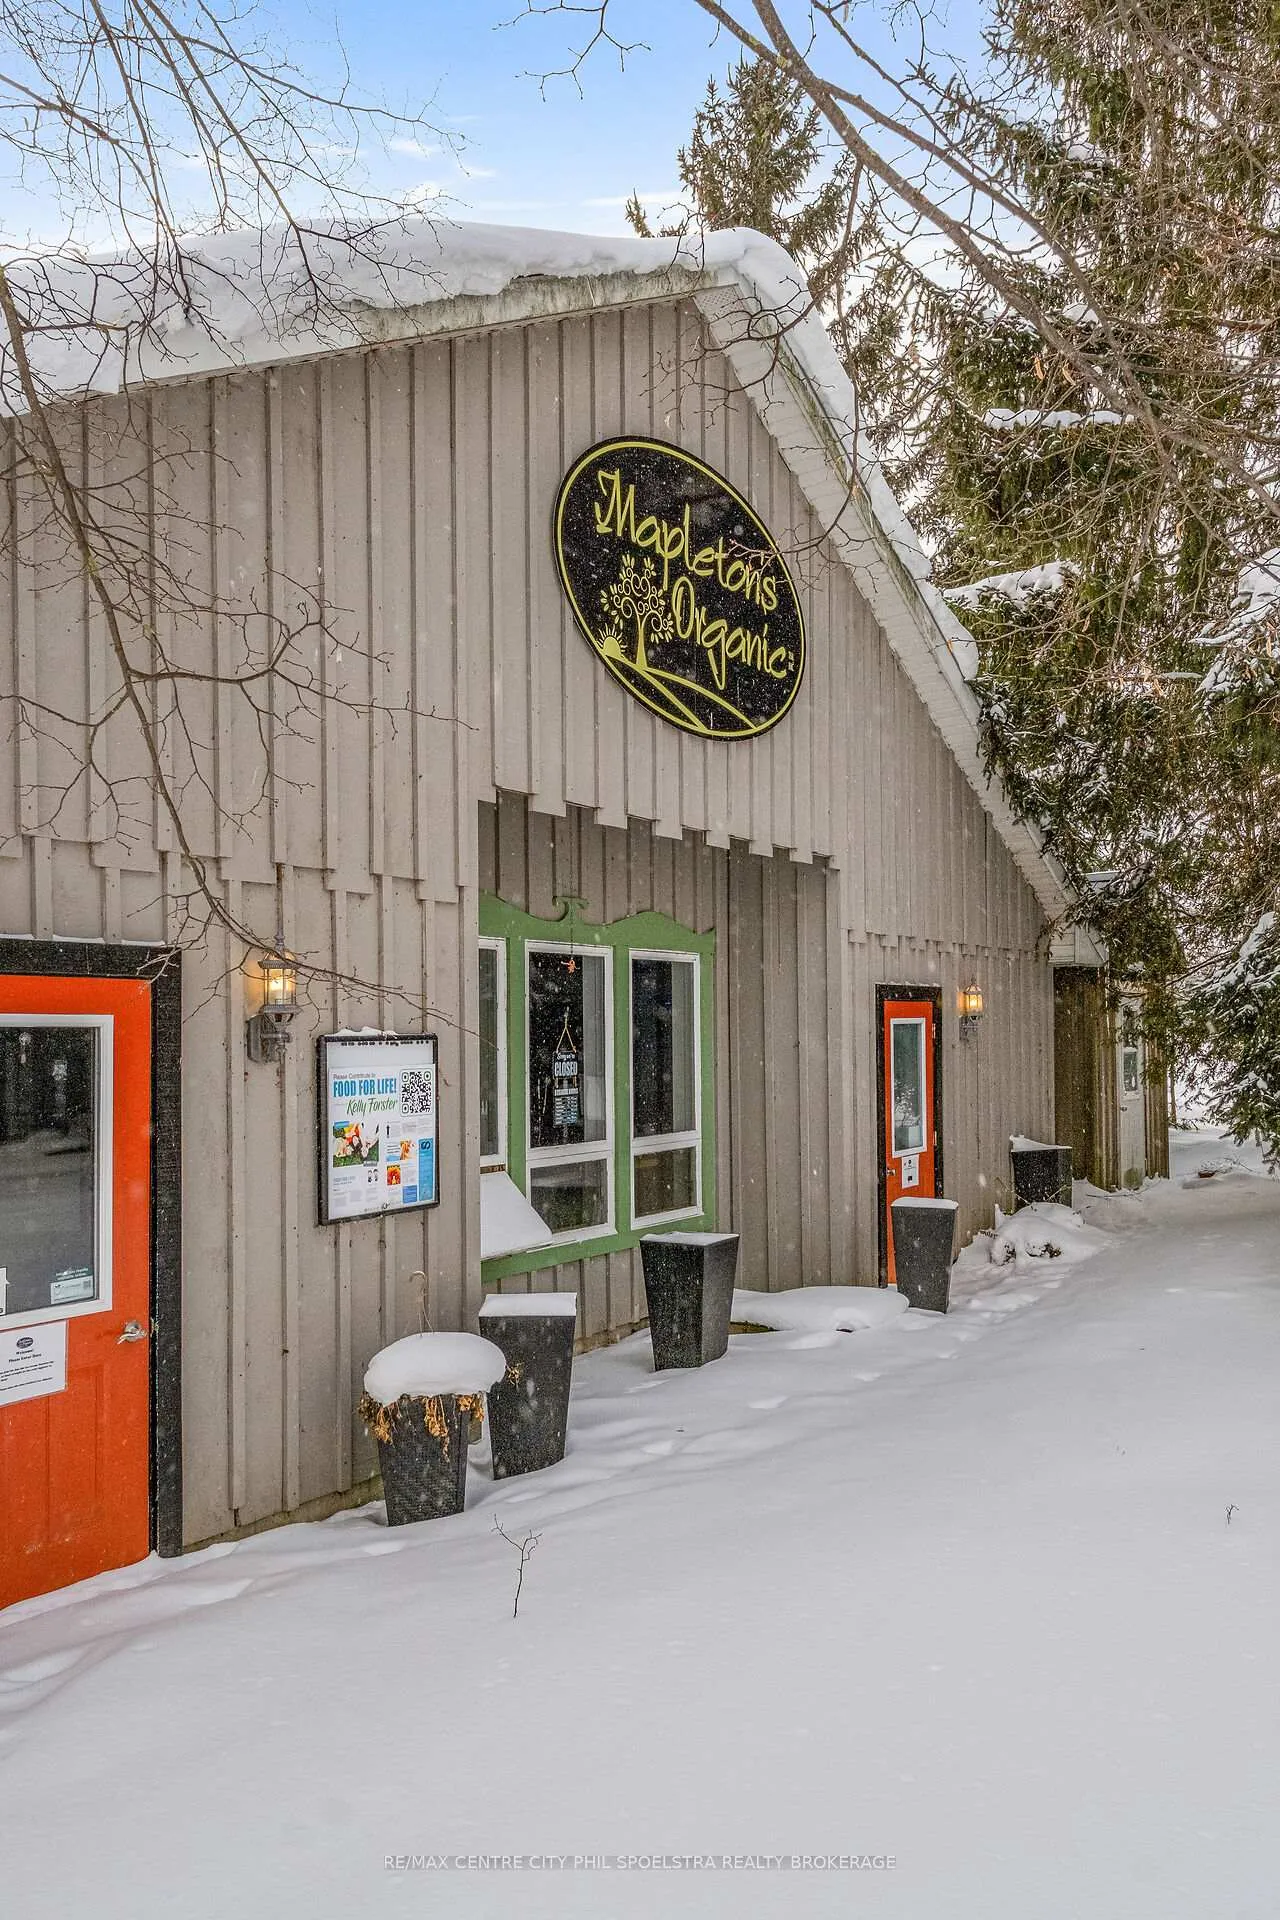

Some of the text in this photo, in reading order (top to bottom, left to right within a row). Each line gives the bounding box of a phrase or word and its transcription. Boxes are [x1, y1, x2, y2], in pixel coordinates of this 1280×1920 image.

[671, 576, 787, 690] Organic
[554, 1061, 578, 1076] CLOSED
[333, 1077, 397, 1098] FOOD FOR LIFE!
[346, 1097, 398, 1117] Kelly Forster
